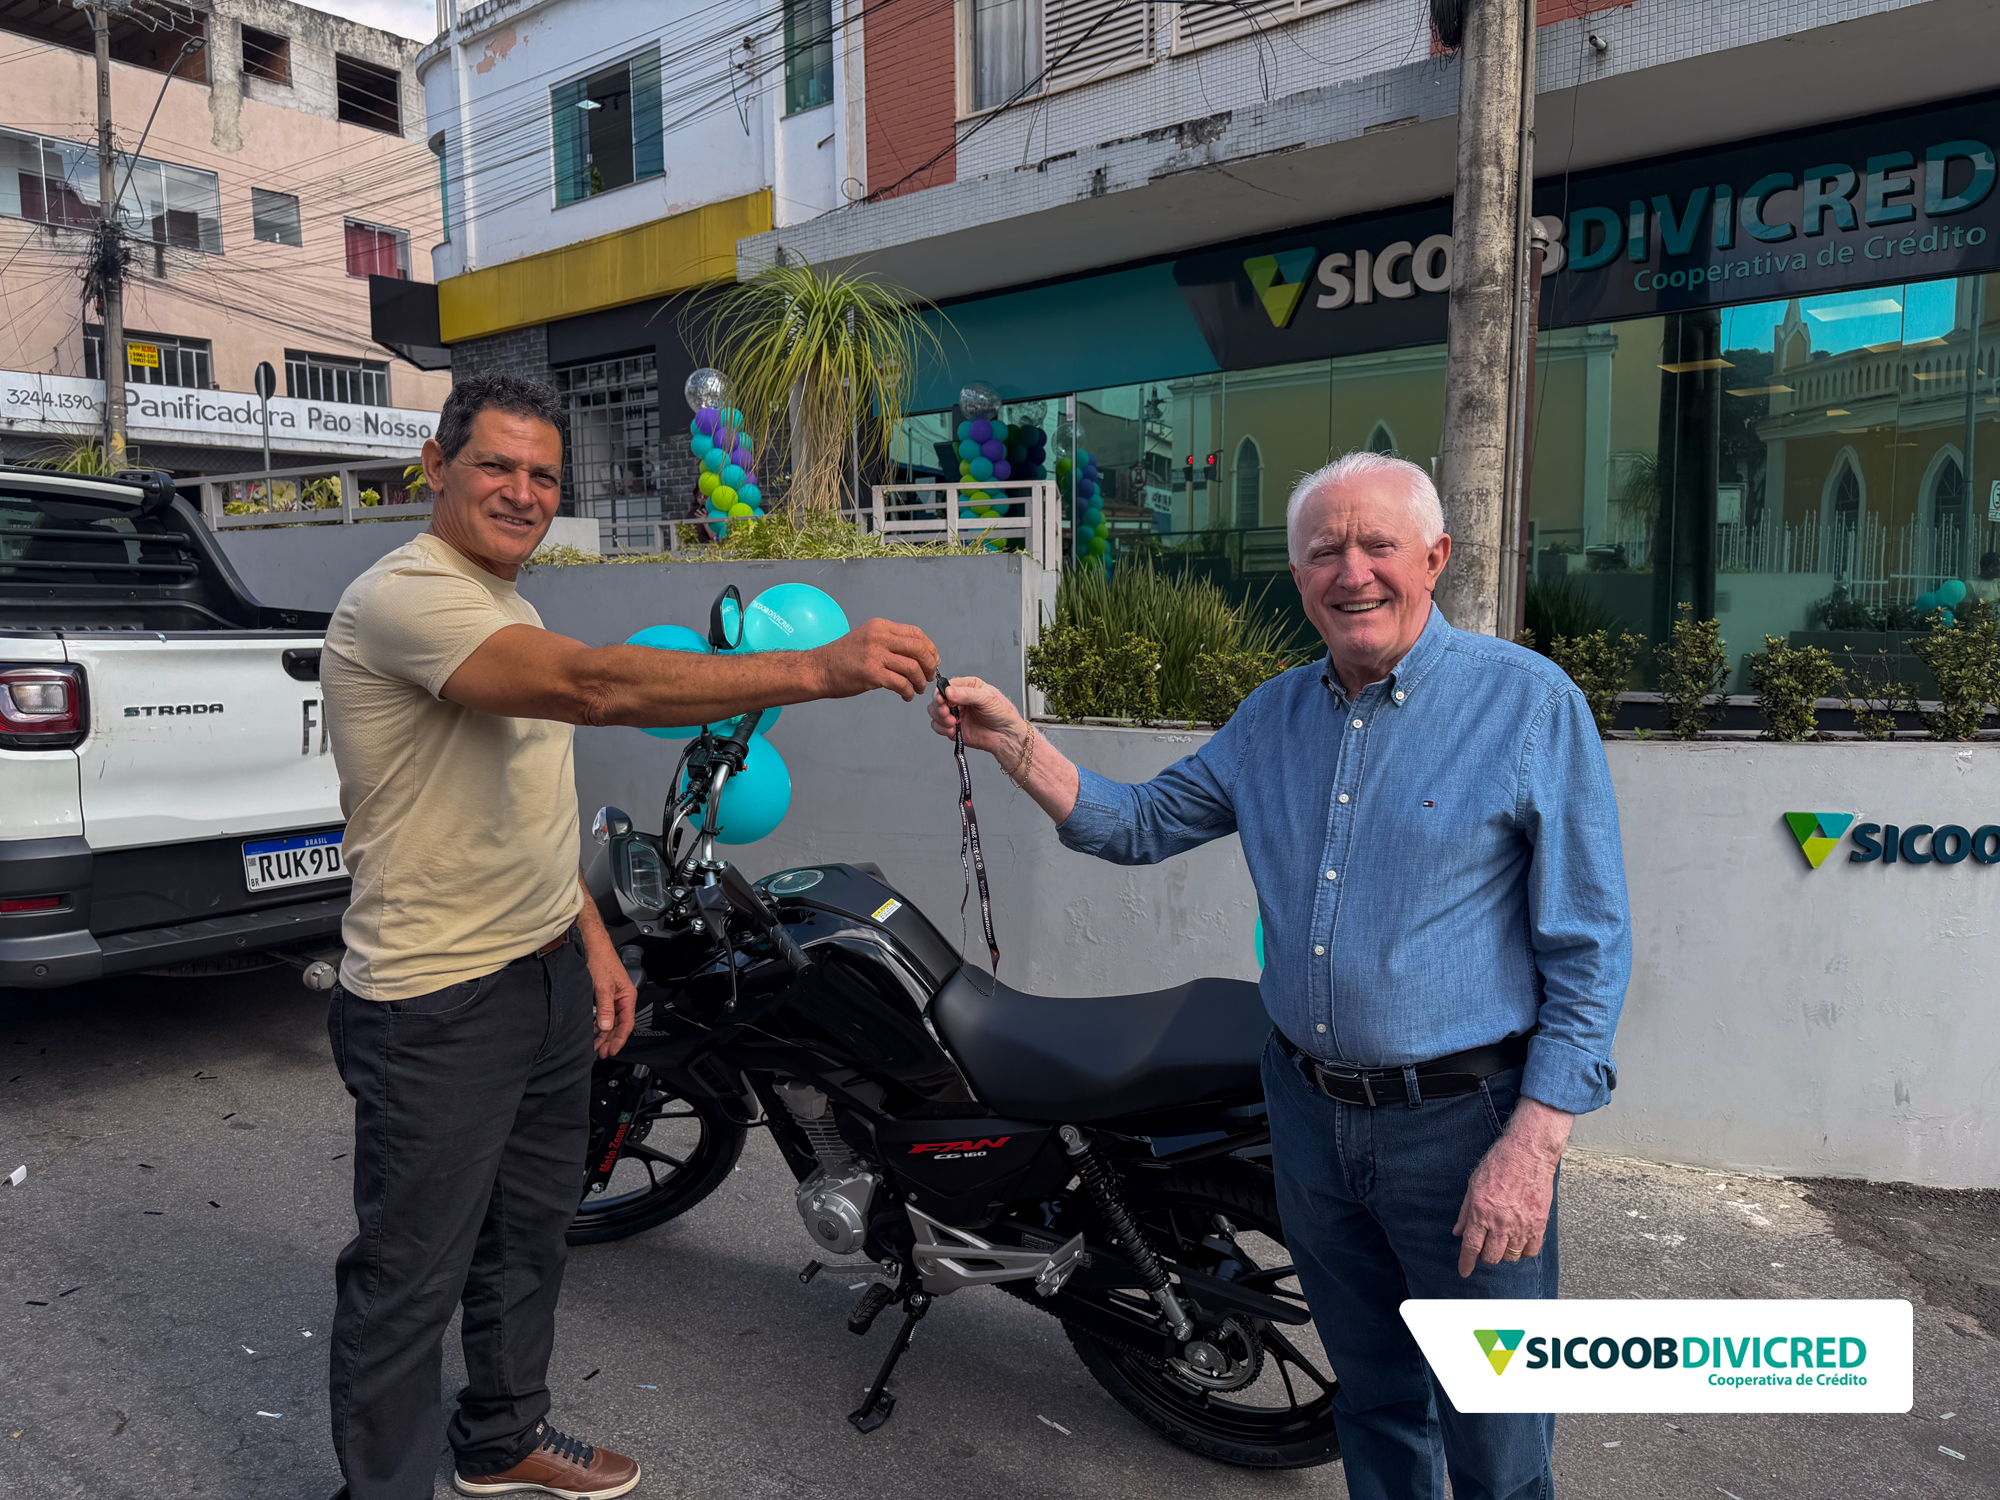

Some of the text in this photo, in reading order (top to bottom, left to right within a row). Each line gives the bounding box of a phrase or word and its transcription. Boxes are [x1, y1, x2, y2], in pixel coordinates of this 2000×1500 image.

[1317, 139, 1997, 309] SICOBDIVICRED
[1634, 225, 1987, 292] Cooperativa de Crédito
[6, 388, 93, 410] 3244.1390
[125, 388, 295, 428] Panificadora
[364, 411, 432, 438] Nosso
[124, 704, 224, 717] STRADA
[304, 837, 328, 846] BRASIL
[1850, 822, 2000, 864] SICOO
[258, 846, 341, 882] RUK9D
[251, 878, 260, 887] BR
[599, 1123, 629, 1173] Moto Zema
[908, 1136, 1011, 1154] FAN
